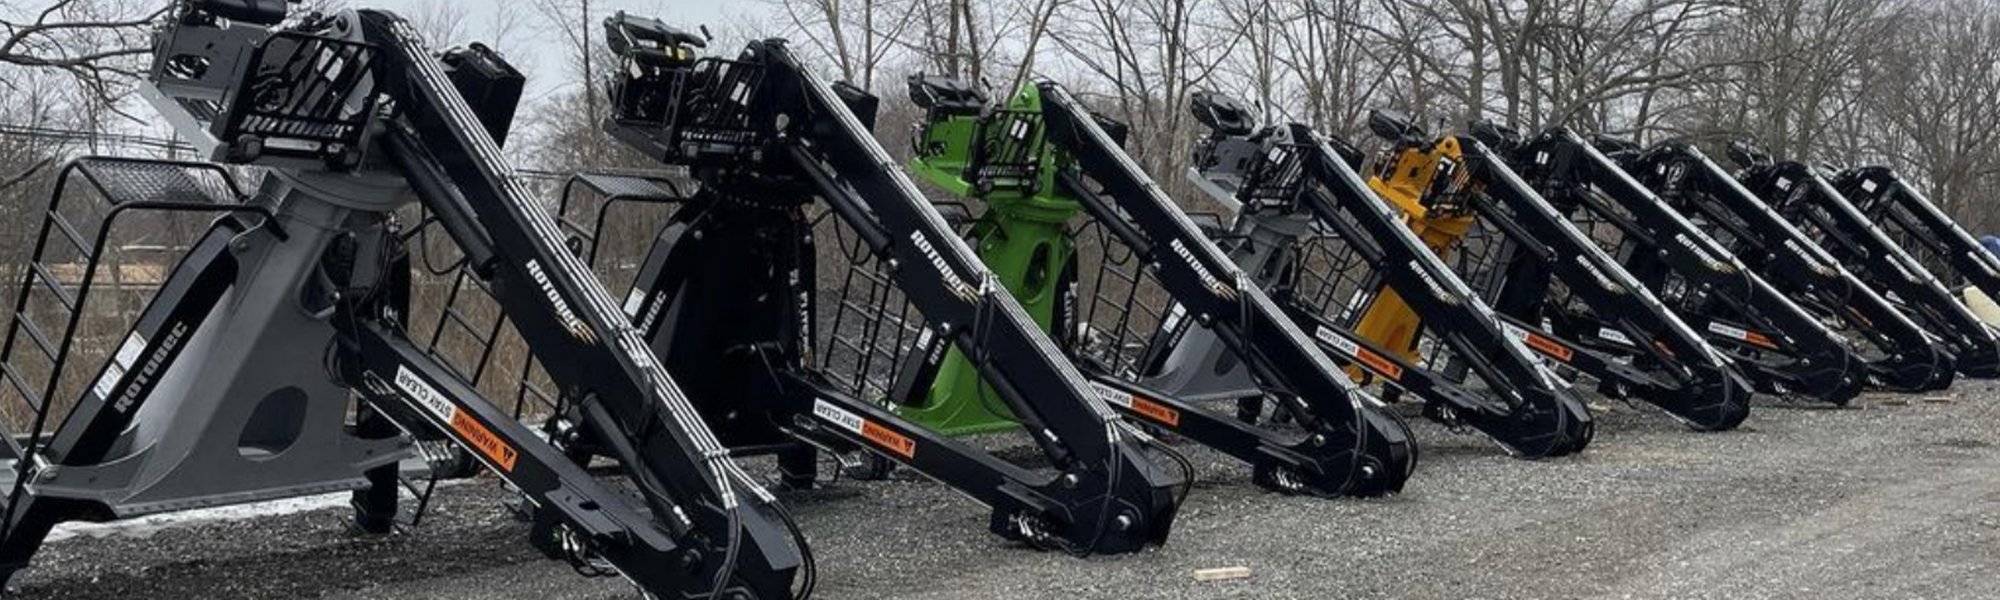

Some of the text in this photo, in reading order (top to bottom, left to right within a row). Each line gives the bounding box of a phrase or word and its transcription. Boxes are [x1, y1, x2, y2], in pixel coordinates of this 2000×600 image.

[910, 229, 970, 295] ROTOBEC
[1170, 238, 1225, 295] ROTOBEC
[526, 259, 588, 336] ROTOBEC
[639, 290, 667, 337] OBEC
[114, 321, 188, 413] ROTOBEC
[398, 370, 498, 453] WARNING STAY CLEAR
[817, 402, 841, 420] CLEAR
[842, 414, 860, 429] STAY
